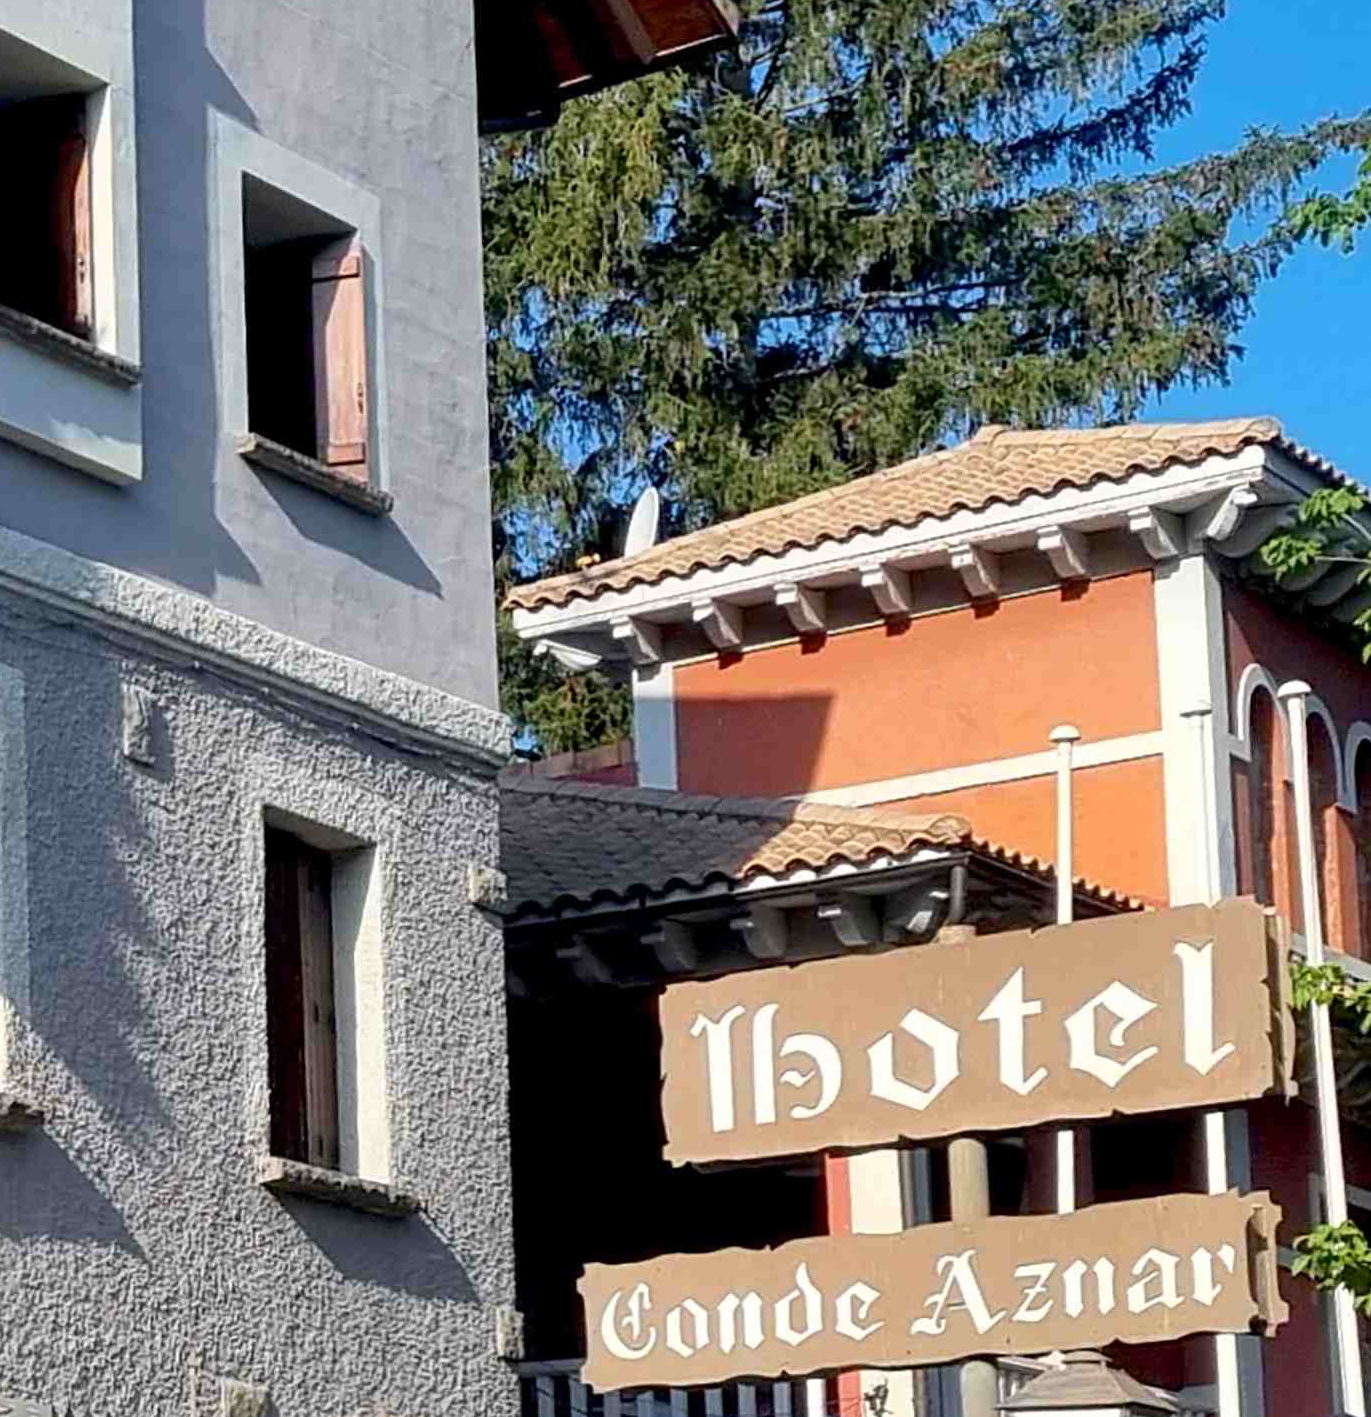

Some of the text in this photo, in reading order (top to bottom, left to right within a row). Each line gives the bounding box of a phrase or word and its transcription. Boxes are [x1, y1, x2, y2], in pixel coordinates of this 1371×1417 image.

[689, 940, 1236, 1133] Hotel
[600, 1242, 1236, 1360] Conde Aznar
